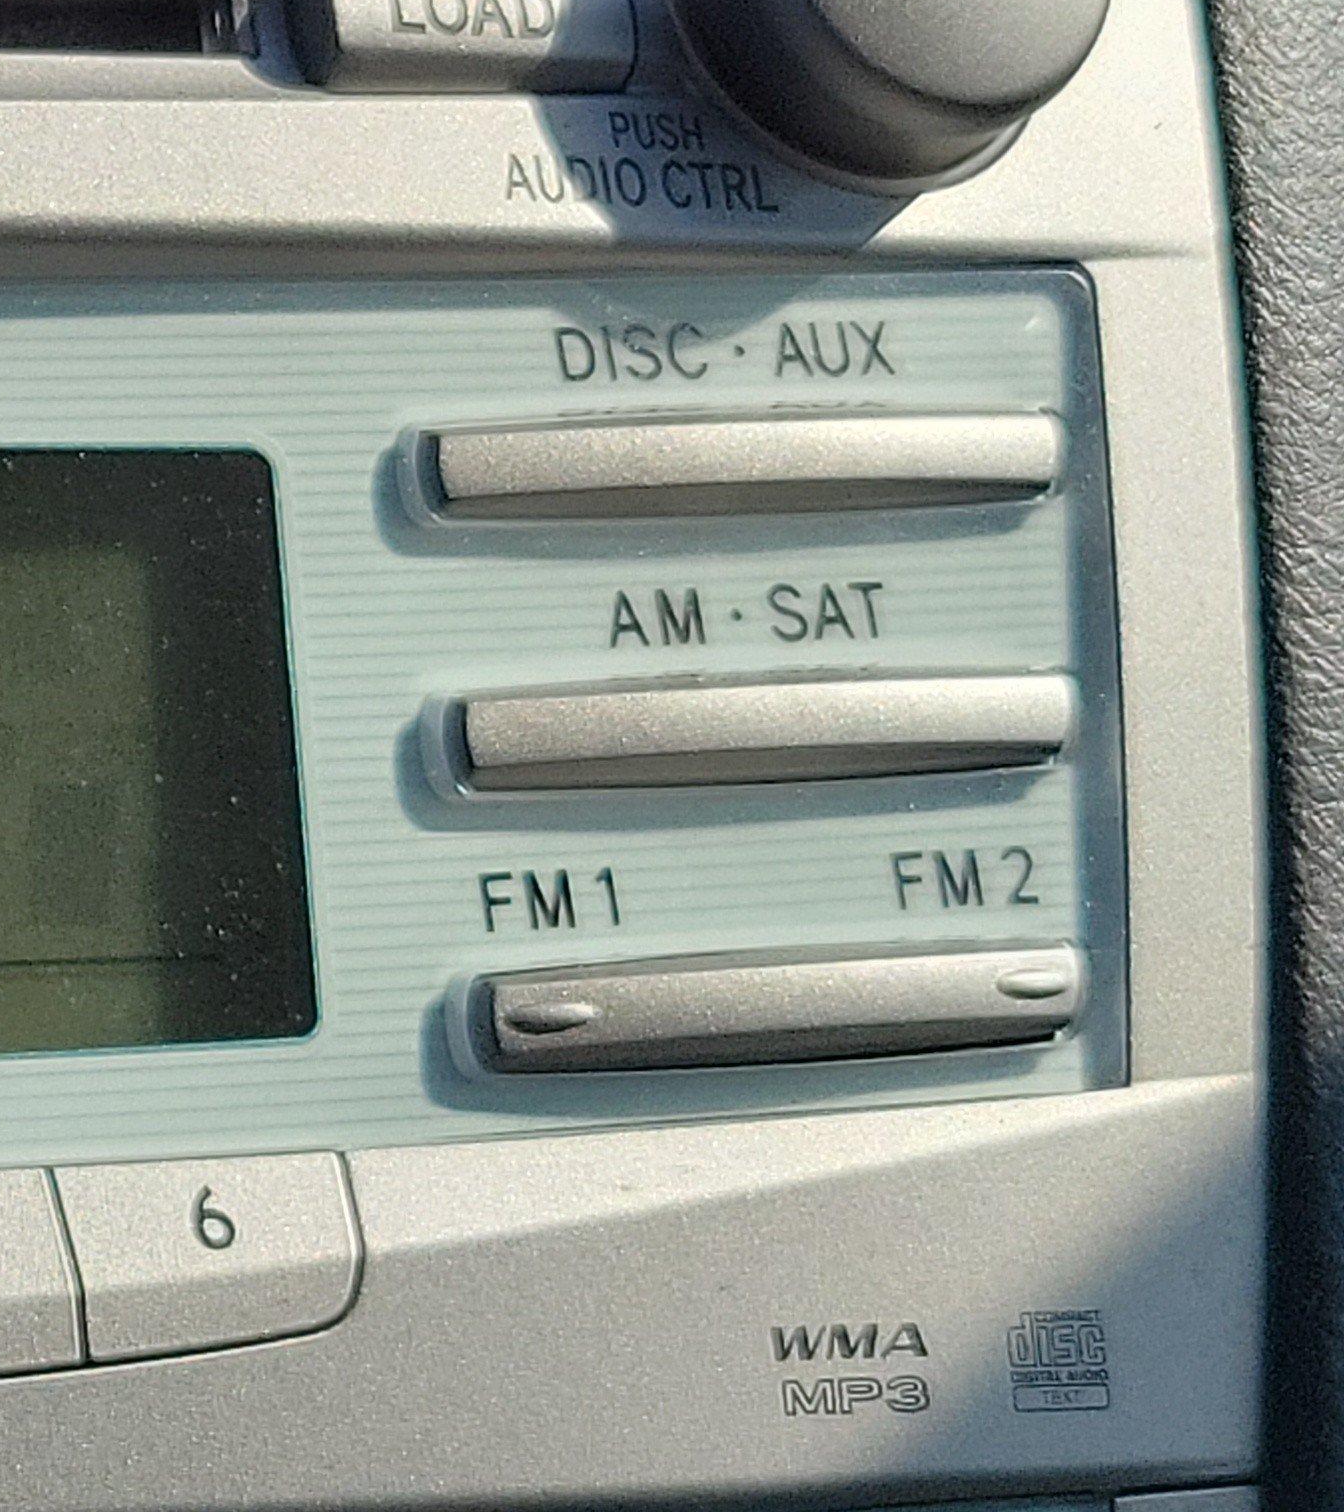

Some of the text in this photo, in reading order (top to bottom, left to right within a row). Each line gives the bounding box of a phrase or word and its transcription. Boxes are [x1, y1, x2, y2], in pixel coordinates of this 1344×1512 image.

[610, 111, 706, 151] PUSH
[505, 154, 780, 214] AUDIO CTRL
[555, 320, 895, 382] DISC AUX
[610, 582, 883, 649] AM SAT
[189, 1185, 237, 1251] 6
[769, 1321, 929, 1362] WMA
[780, 1373, 930, 1417] MP3
